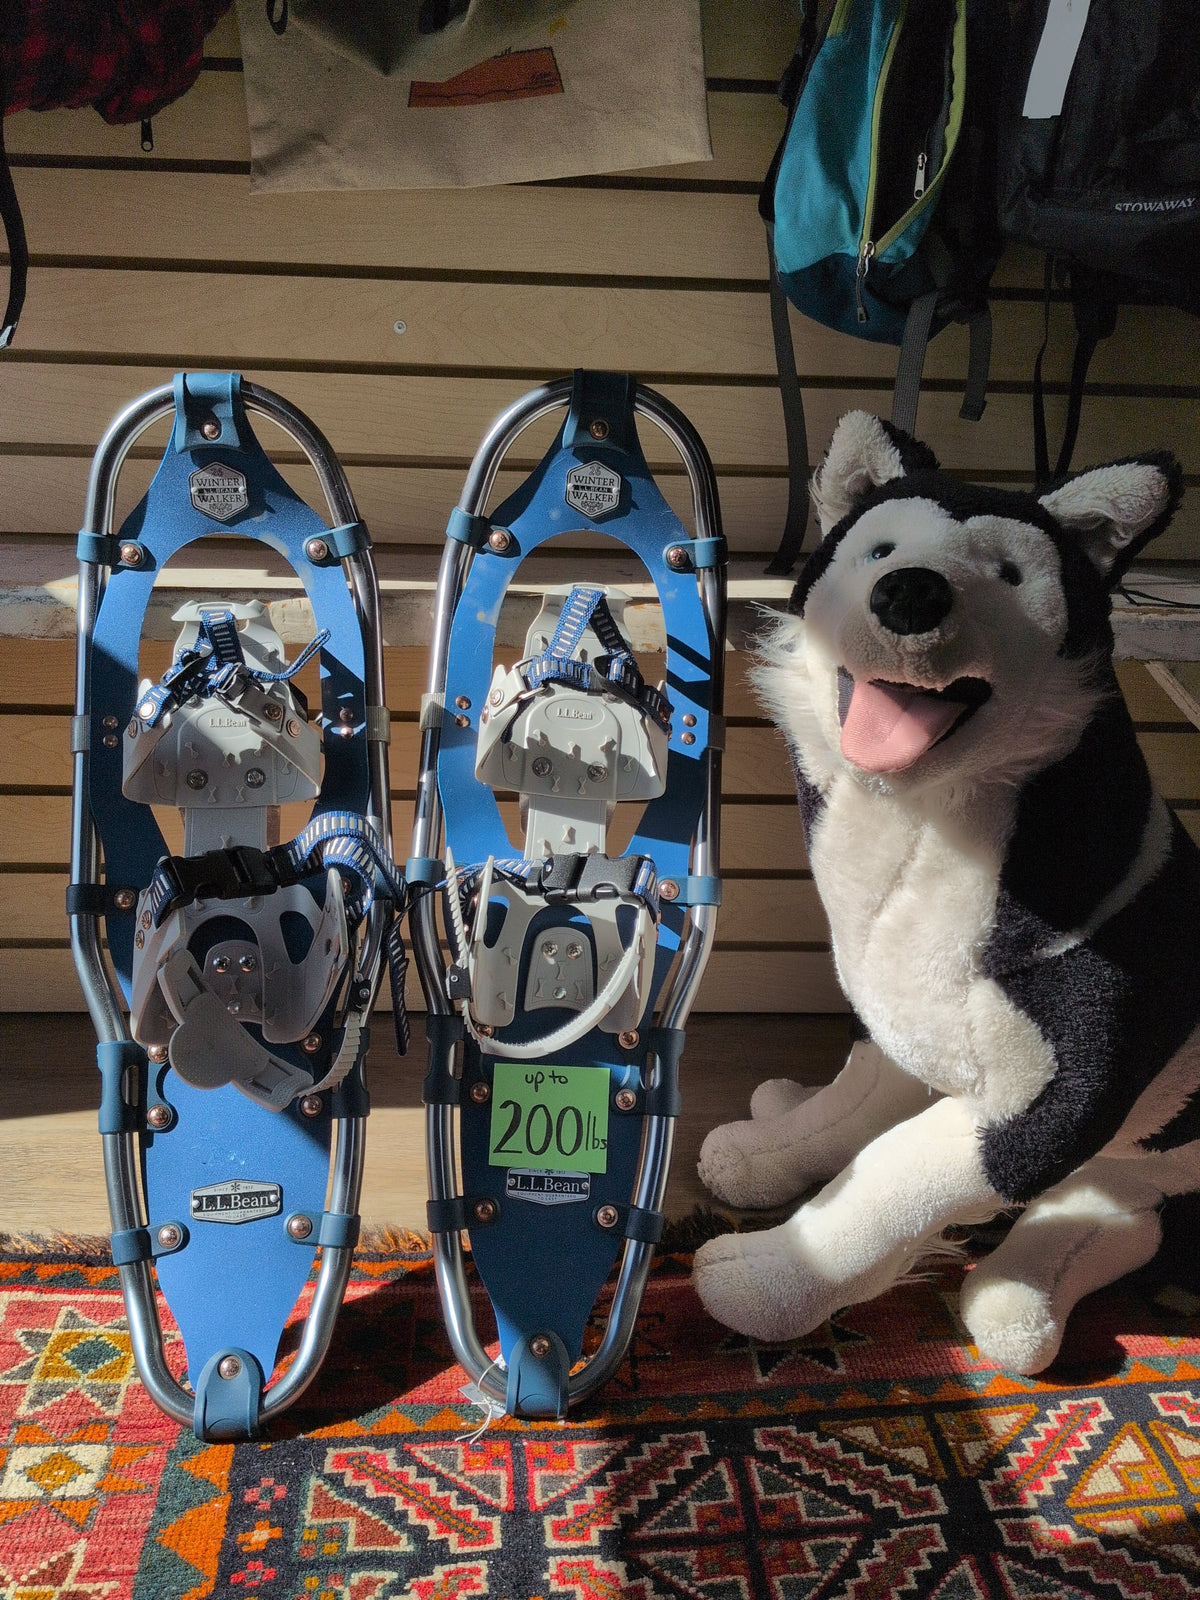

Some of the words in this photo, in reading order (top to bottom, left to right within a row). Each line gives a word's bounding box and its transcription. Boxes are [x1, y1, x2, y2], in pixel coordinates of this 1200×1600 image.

[1114, 197, 1196, 212] STOWAWAY
[196, 477, 241, 487] WINTER
[573, 475, 615, 487] WINTER
[197, 494, 243, 503] WALKER
[571, 491, 614, 503] WALKER
[525, 1071, 545, 1093] up
[548, 1070, 569, 1084] to
[516, 1175, 580, 1193] L.L.Bean
[201, 1194, 269, 1211] L.L.Bean
